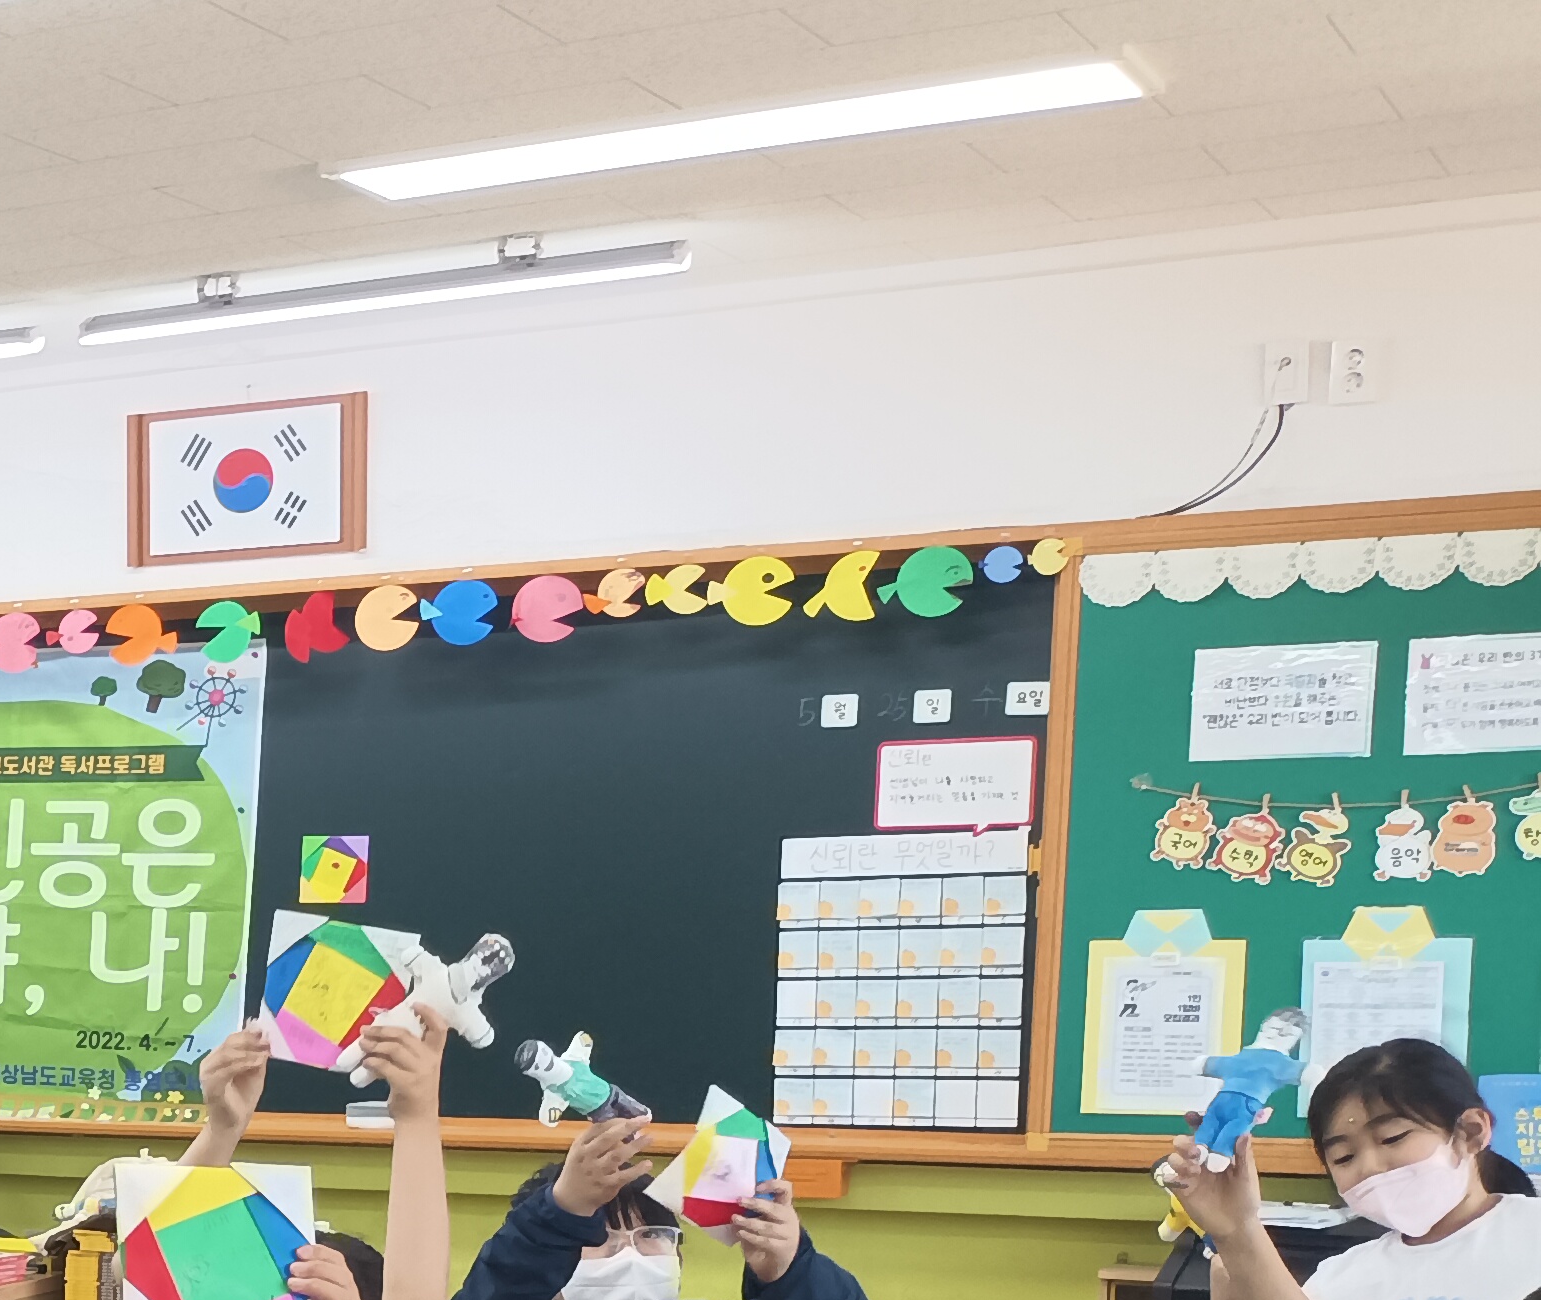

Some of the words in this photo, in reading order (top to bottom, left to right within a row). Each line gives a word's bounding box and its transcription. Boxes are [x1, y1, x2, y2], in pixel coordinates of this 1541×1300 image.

[925, 698, 940, 715] 일
[1016, 690, 1044, 708] 요일
[60, 753, 166, 775] 독서프로그램
[1169, 832, 1198, 850] 국어
[809, 842, 878, 874] 신뢰란
[1228, 847, 1259, 868] 수학
[1298, 849, 1329, 867] 영어
[1390, 847, 1422, 868] 음악
[89, 907, 208, 1014] 나!
[76, 1030, 132, 1051] 2022.
[138, 1033, 158, 1052] 4.
